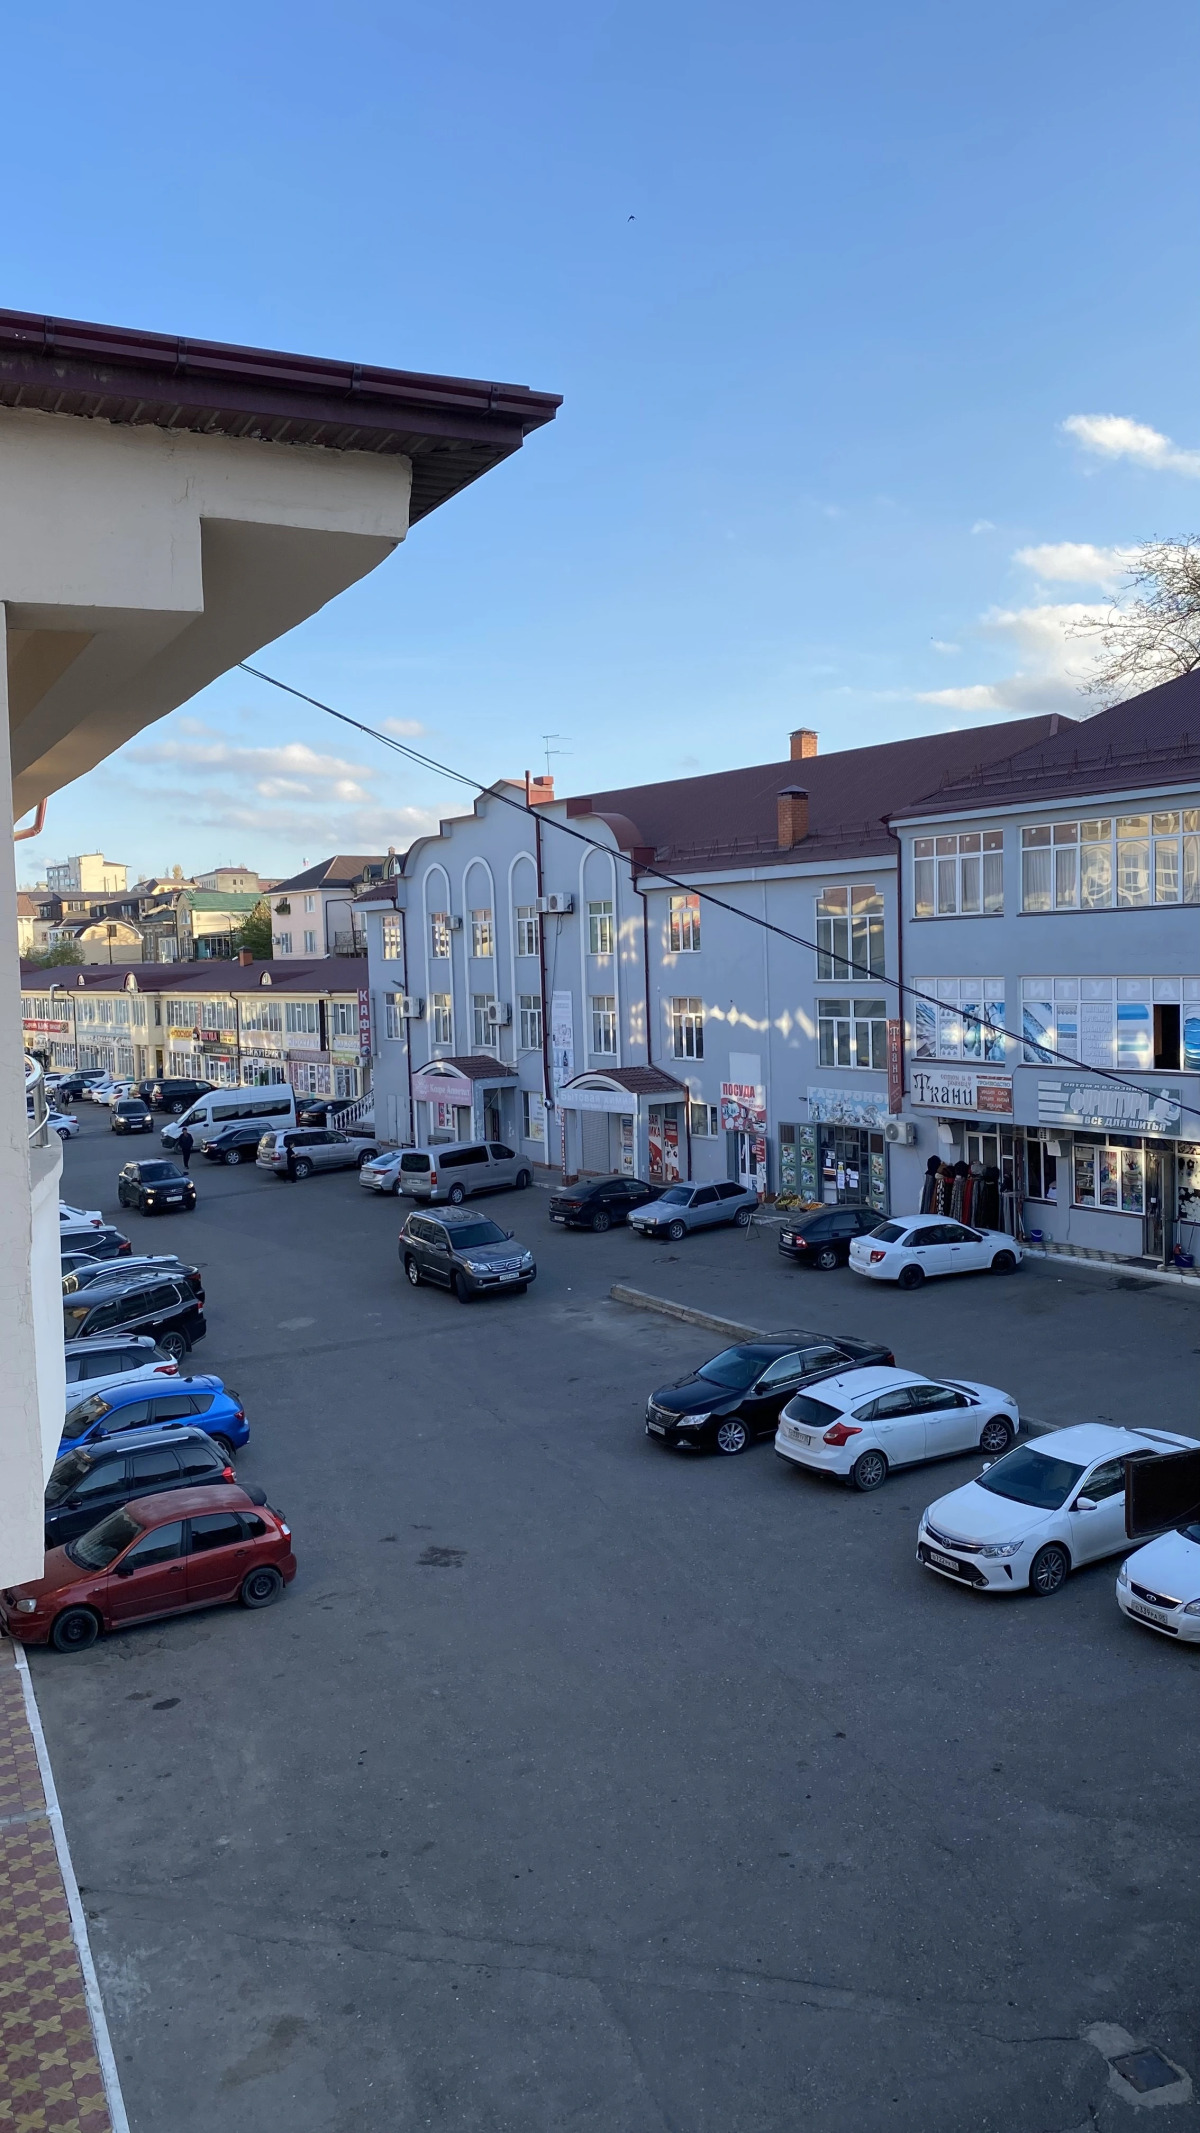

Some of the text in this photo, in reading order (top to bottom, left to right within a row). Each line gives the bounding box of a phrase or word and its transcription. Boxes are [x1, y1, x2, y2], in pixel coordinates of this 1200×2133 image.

[360, 990, 370, 1045] КАФЕ
[722, 1083, 756, 1099] ПОСУДА
[810, 1087, 889, 1105] ГАСТРОНО
[913, 1073, 973, 1106] Ткани
[1069, 1088, 1150, 1120] ФУРНИТУРА
[1084, 1116, 1167, 1131] ВСЕ ДЛЯ ШИТЬЯ
